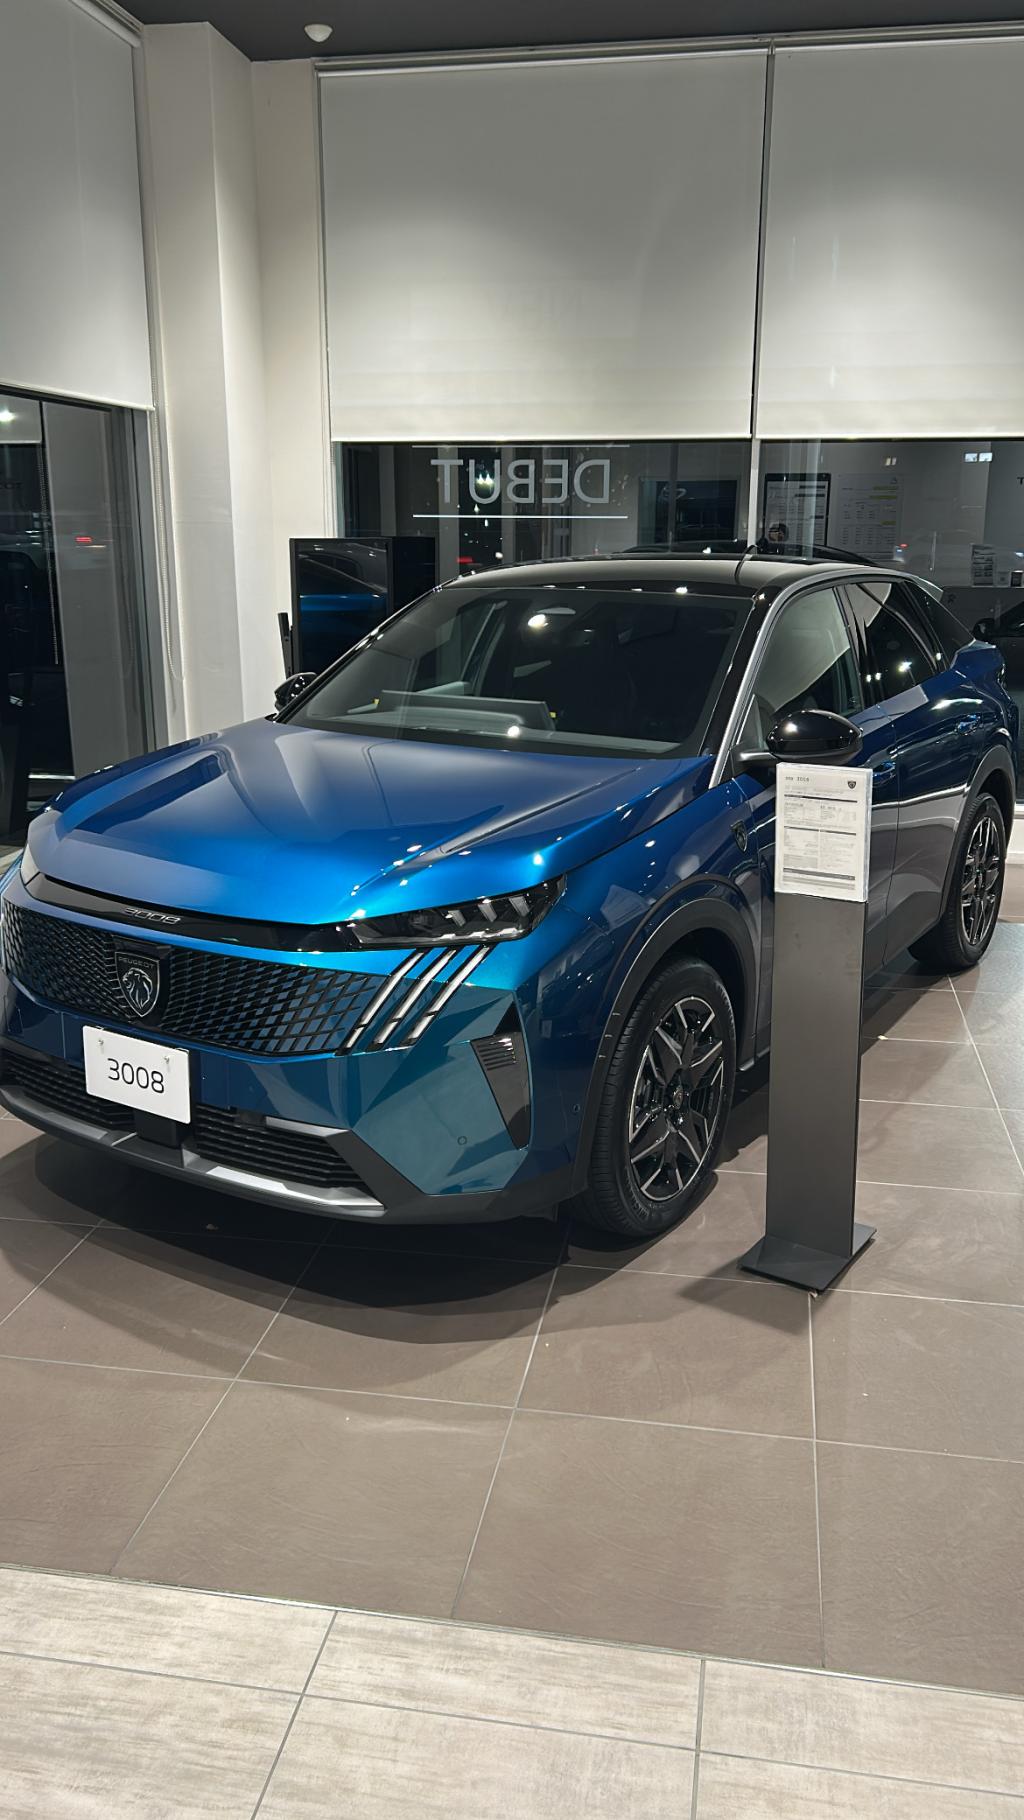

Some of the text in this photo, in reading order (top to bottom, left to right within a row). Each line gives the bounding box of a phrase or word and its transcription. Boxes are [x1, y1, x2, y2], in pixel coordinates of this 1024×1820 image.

[124, 907, 181, 925] 3008
[118, 956, 155, 969] PEUGEOT
[107, 1058, 165, 1094] 3008
